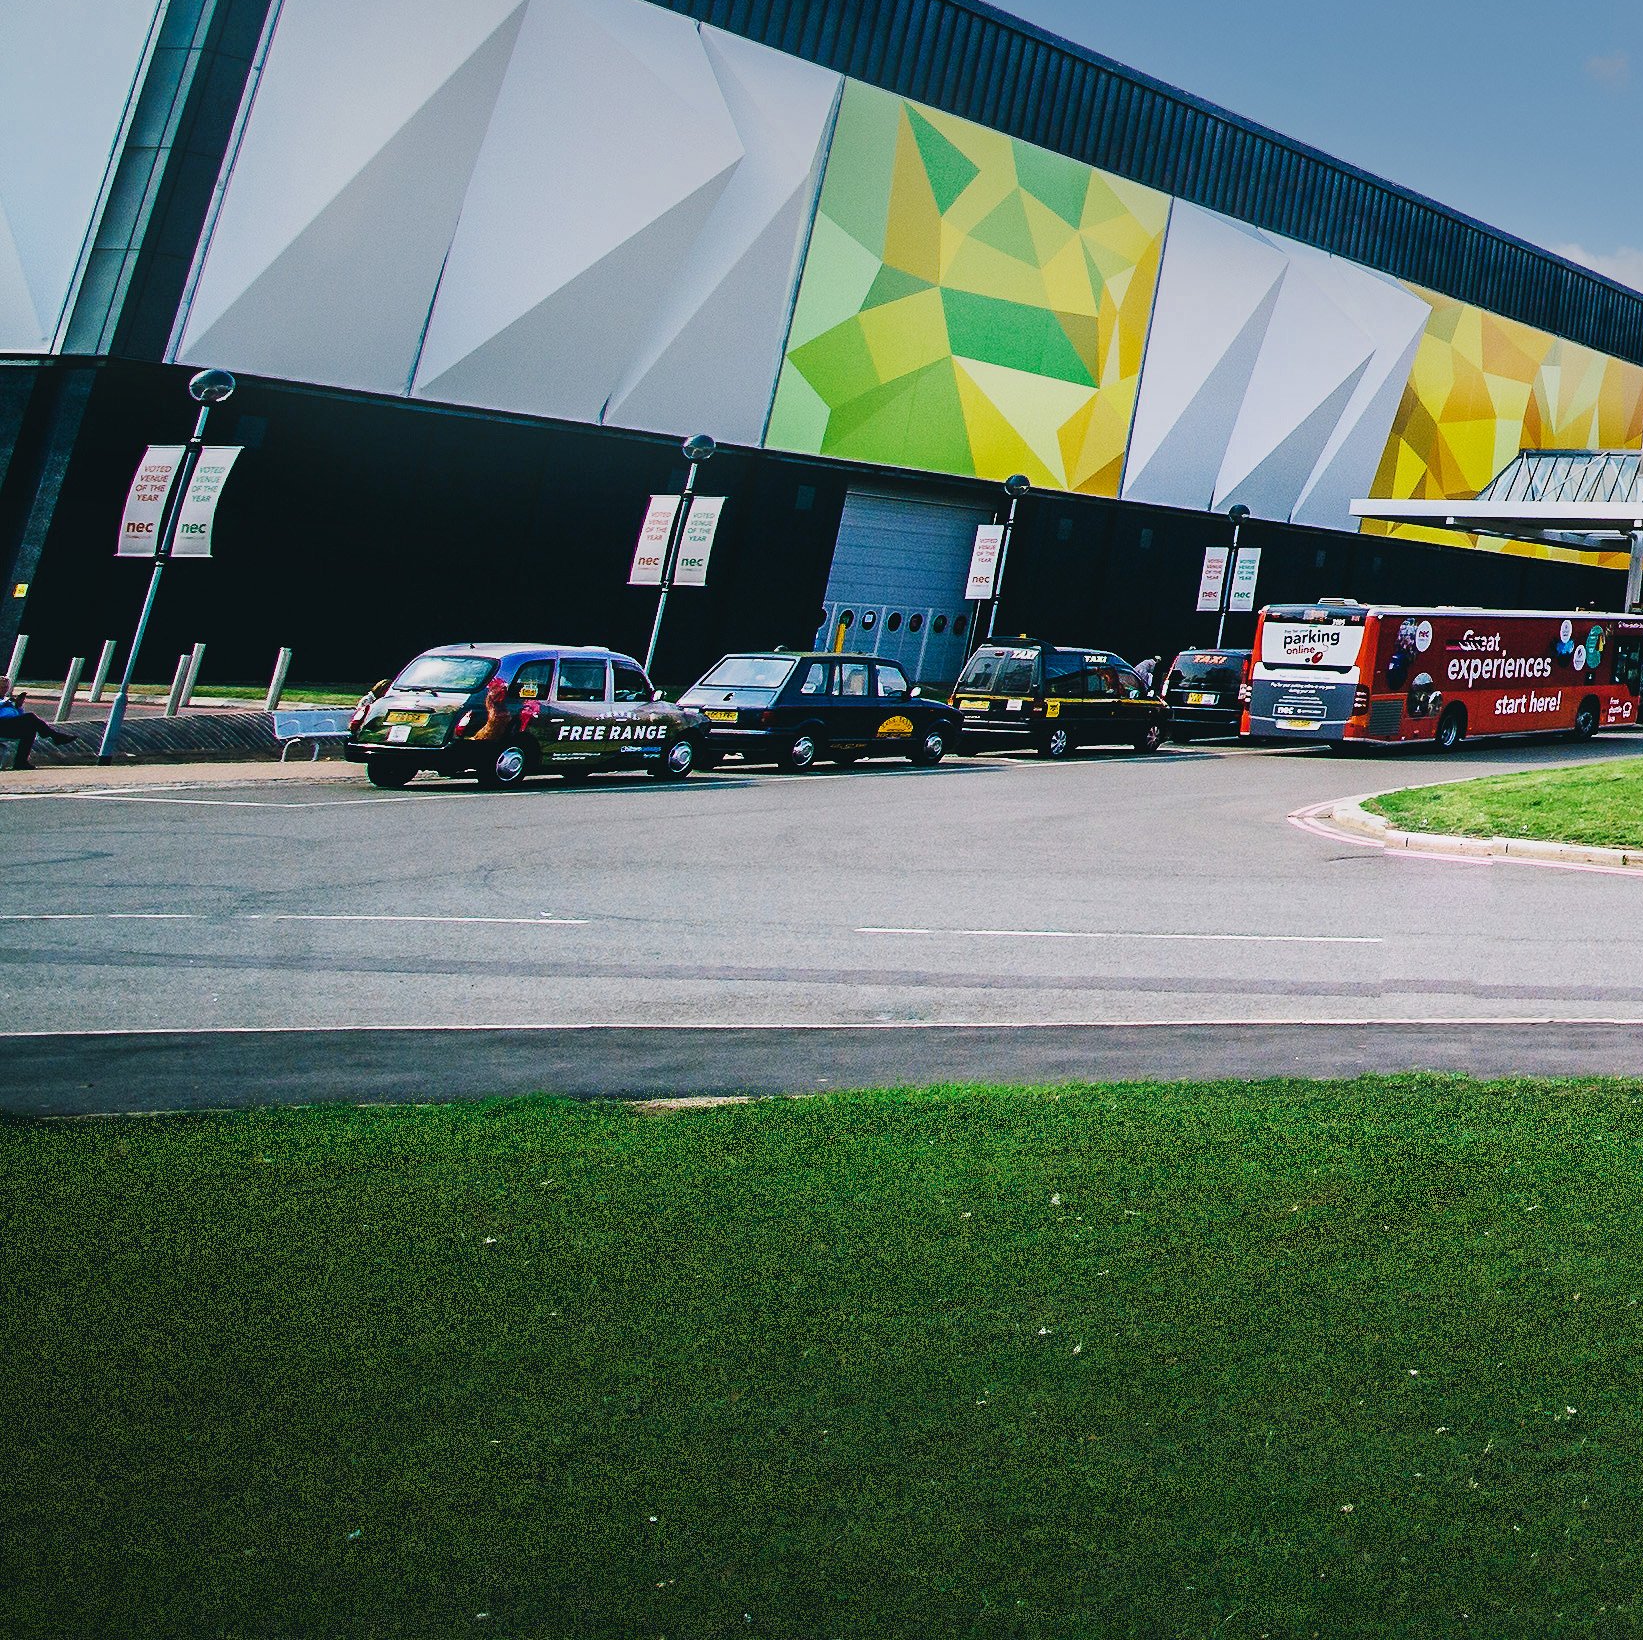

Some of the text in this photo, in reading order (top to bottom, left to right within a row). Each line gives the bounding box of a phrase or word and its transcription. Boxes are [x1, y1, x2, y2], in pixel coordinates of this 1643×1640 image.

[144, 465, 172, 473] VOTED
[199, 466, 225, 474] VOTED
[140, 475, 169, 483] VENUE
[135, 484, 166, 492] OF THE
[191, 485, 219, 493] OF THE
[136, 494, 159, 502] YEAR
[126, 522, 155, 533] nec
[181, 523, 207, 534] nec
[638, 557, 660, 566] nec
[681, 558, 704, 567] nec
[1284, 629, 1340, 649] parking
[1459, 630, 1501, 652] Great
[1286, 644, 1316, 655] online
[1011, 650, 1039, 659] TAXI
[1083, 655, 1108, 663] TAXI
[1447, 649, 1552, 689] experiences
[1494, 691, 1562, 715] start here!
[558, 725, 667, 740] FREE RANGE
